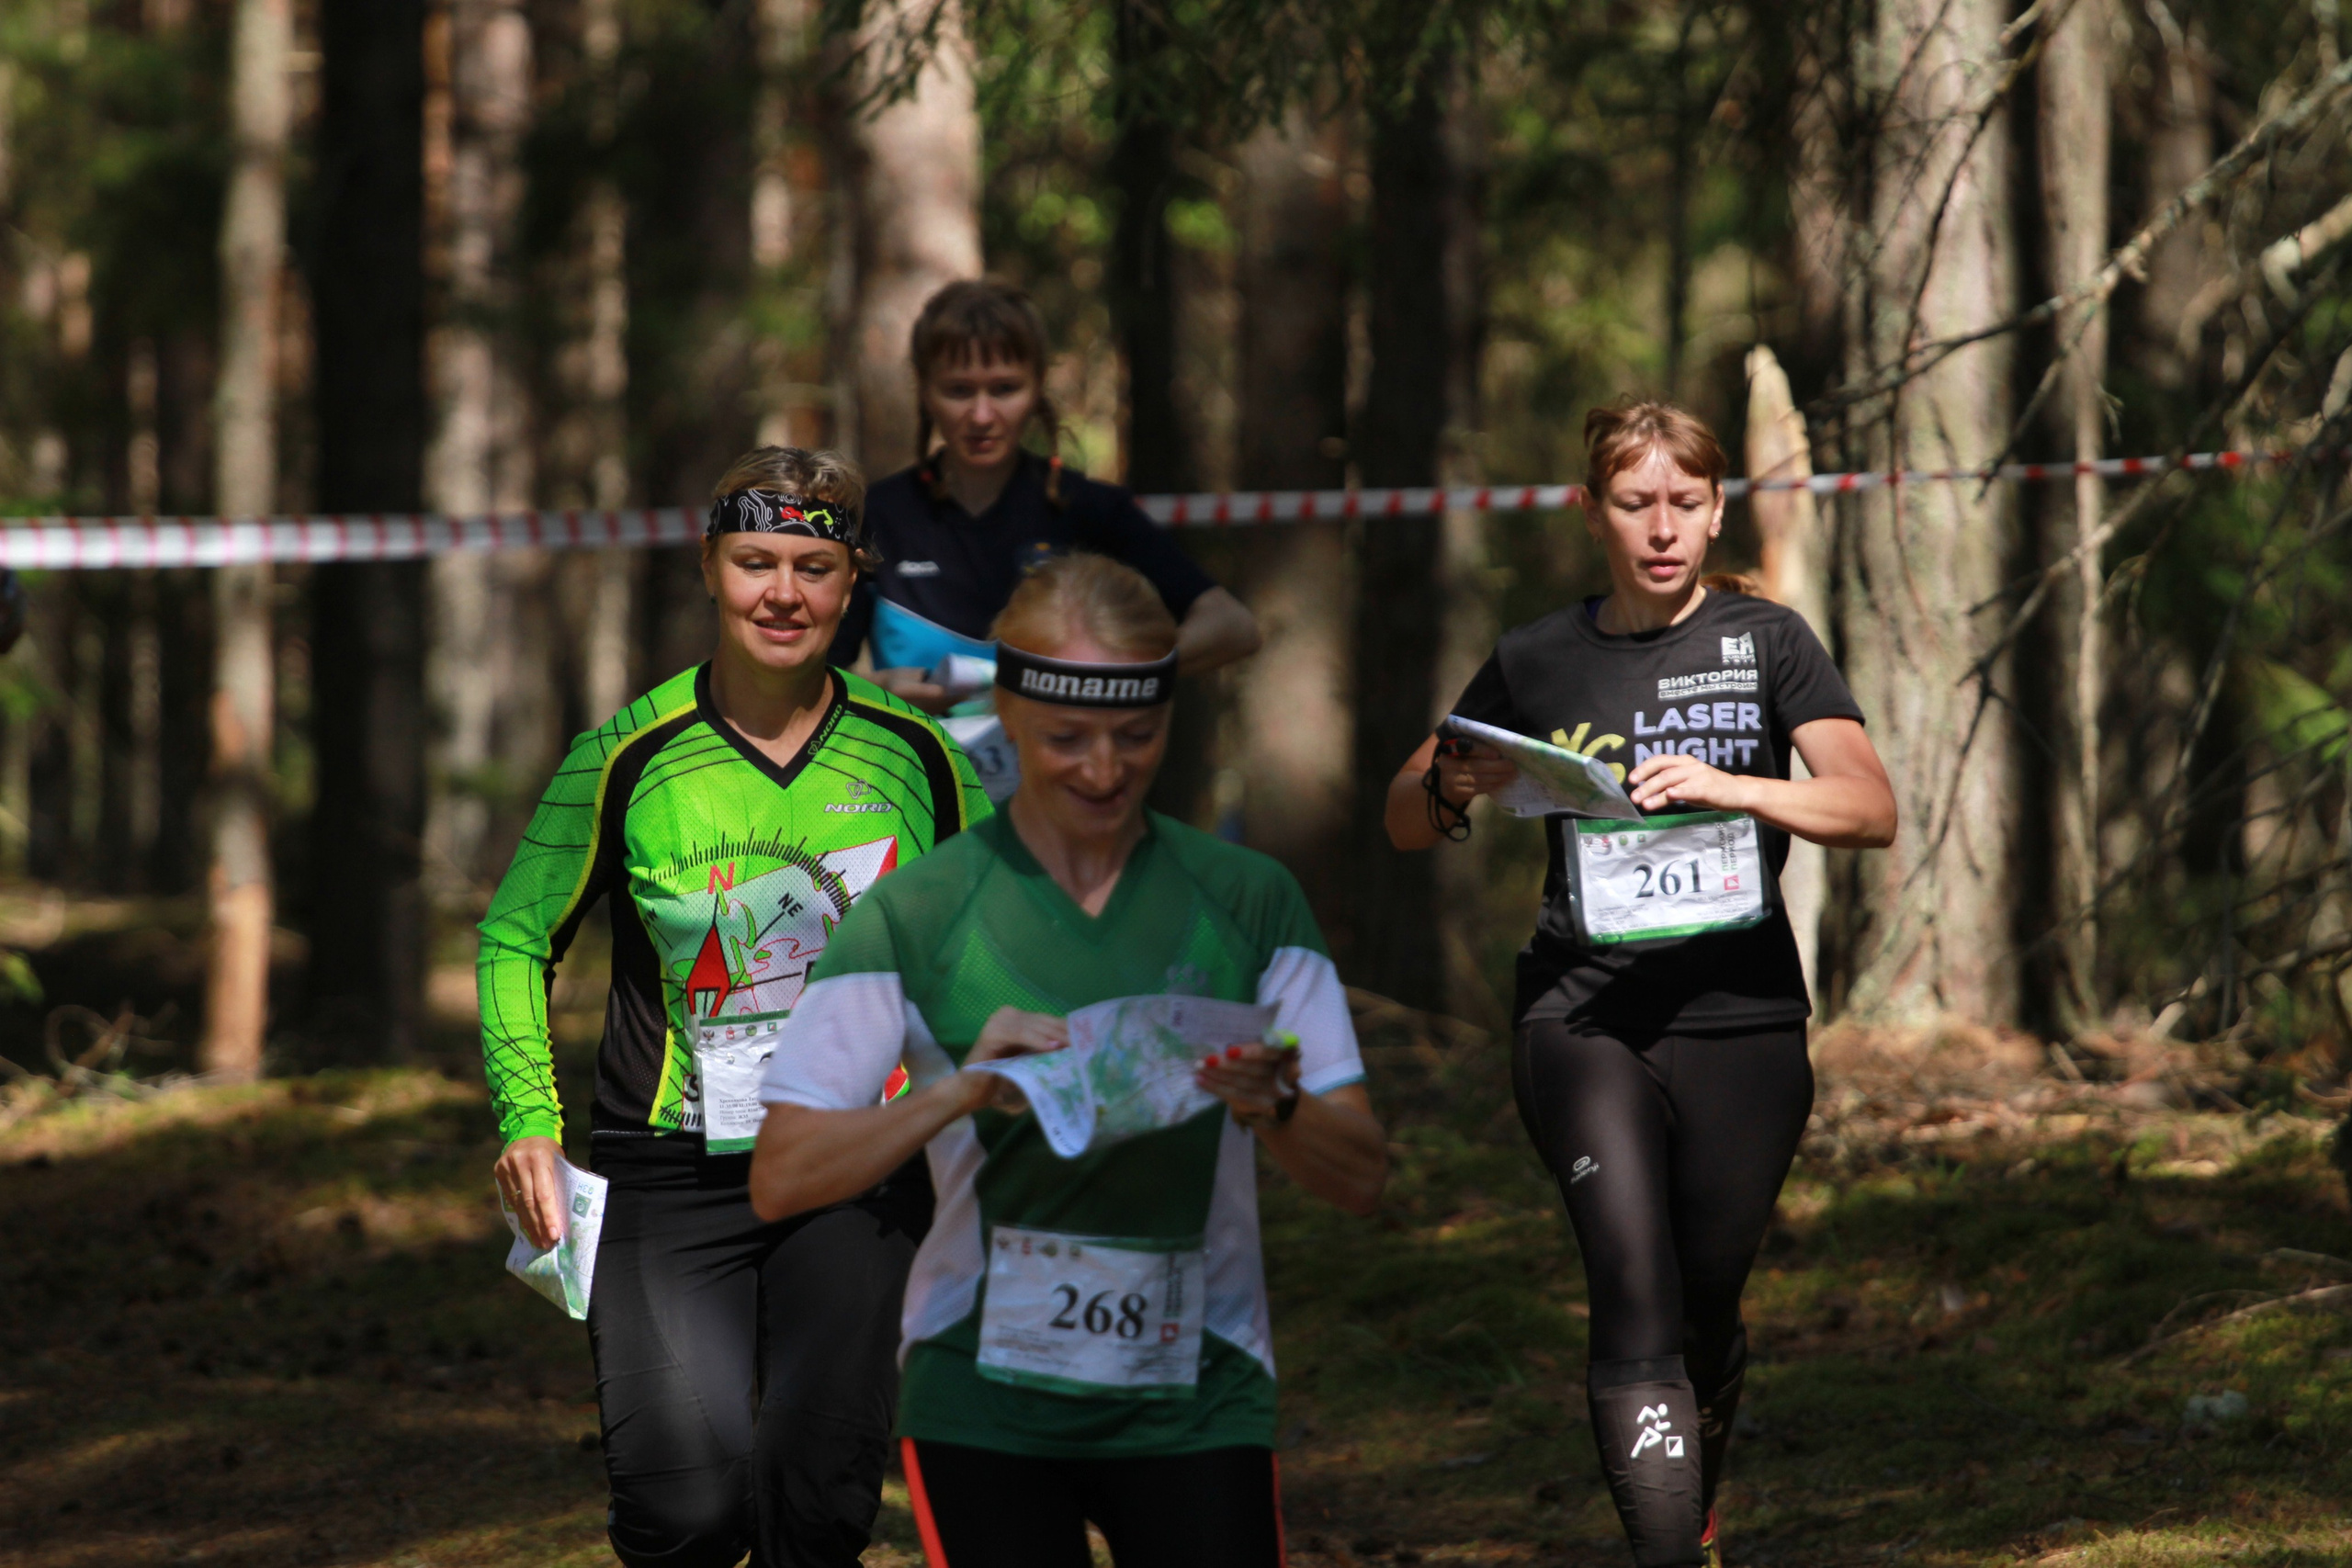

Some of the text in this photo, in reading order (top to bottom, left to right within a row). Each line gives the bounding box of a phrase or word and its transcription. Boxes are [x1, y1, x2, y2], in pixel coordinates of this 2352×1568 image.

[1021, 668, 1160, 699] noname
[1657, 669, 1758, 690] ВИКТОРИЯ
[820, 704, 842, 741] NORD
[1634, 702, 1762, 737] LASER
[1634, 736, 1759, 769] NIGHT
[823, 802, 893, 814] NORD
[707, 862, 735, 895] N
[1633, 857, 1705, 898] 261
[777, 892, 804, 919] NE
[726, 1010, 791, 1024] ВСЕРОССИЙСК
[1048, 1283, 1148, 1340] 268
